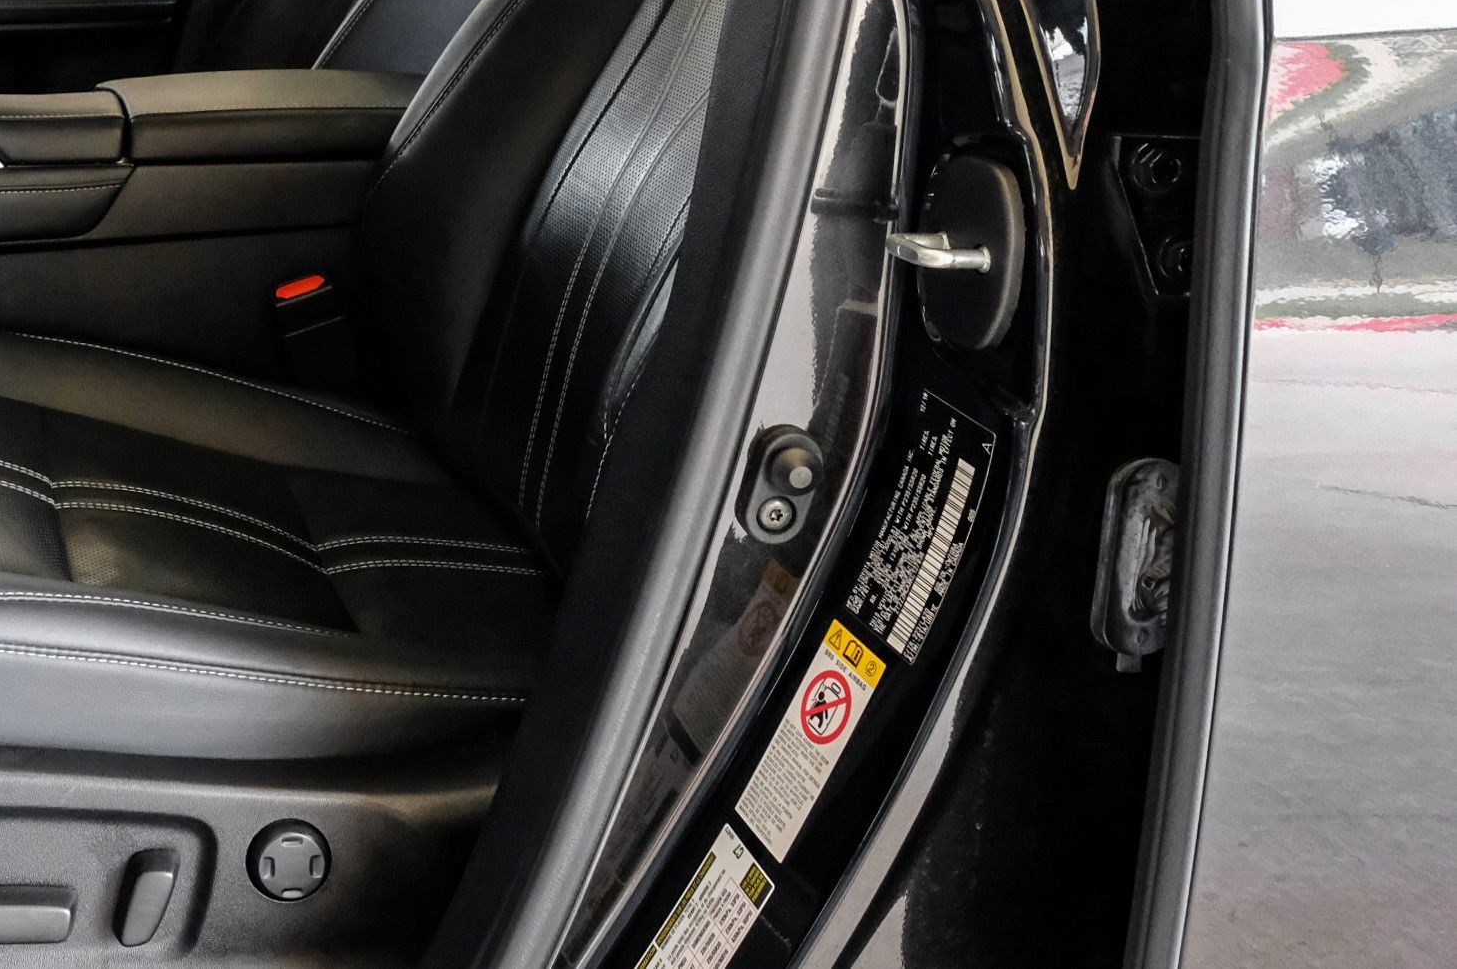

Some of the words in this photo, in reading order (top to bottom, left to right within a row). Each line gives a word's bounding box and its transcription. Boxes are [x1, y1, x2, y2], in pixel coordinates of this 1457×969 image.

[981, 444, 992, 454] A
[877, 489, 901, 539] MANUFACTURING
[897, 464, 909, 489] CANADA
[868, 663, 875, 674] 2
[848, 672, 866, 690] AIRBAG
[733, 844, 744, 859] C7
